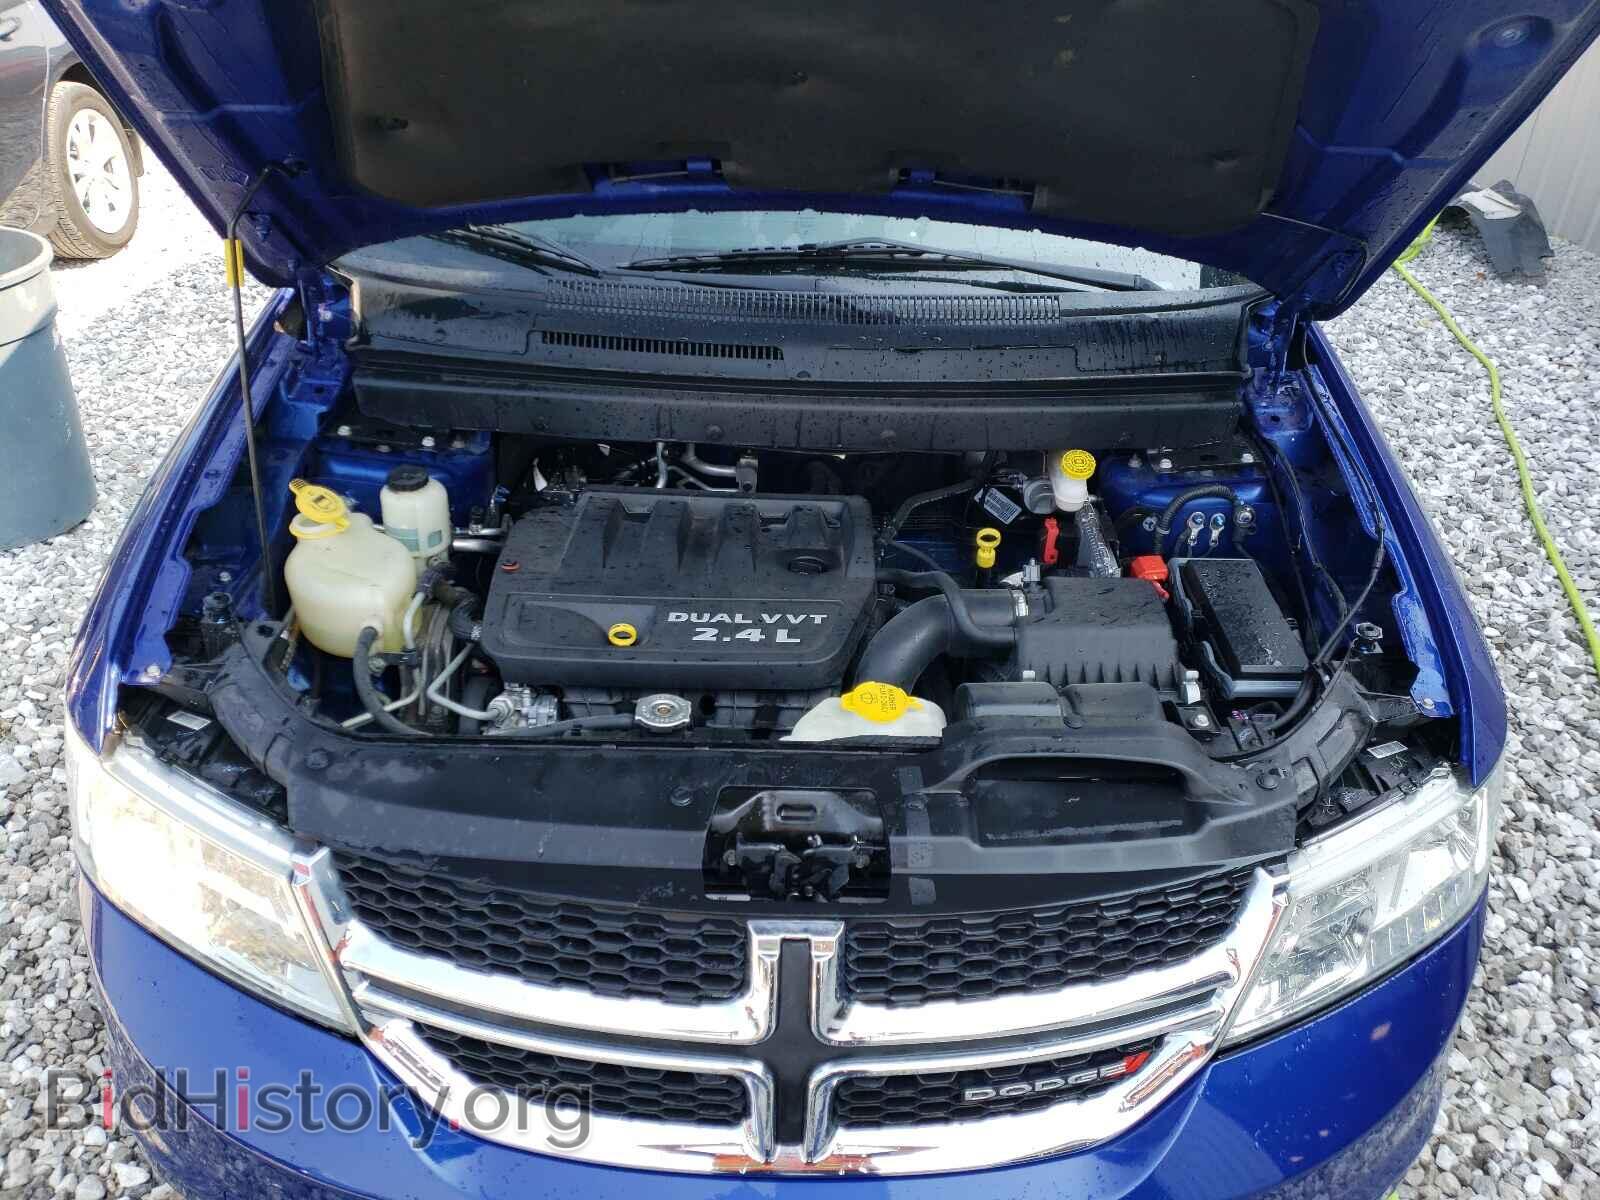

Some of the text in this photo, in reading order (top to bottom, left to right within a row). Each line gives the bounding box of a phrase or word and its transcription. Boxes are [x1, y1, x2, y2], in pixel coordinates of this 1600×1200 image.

[667, 612, 828, 625] DUAL VVT
[964, 1062, 1127, 1101] DODGE
